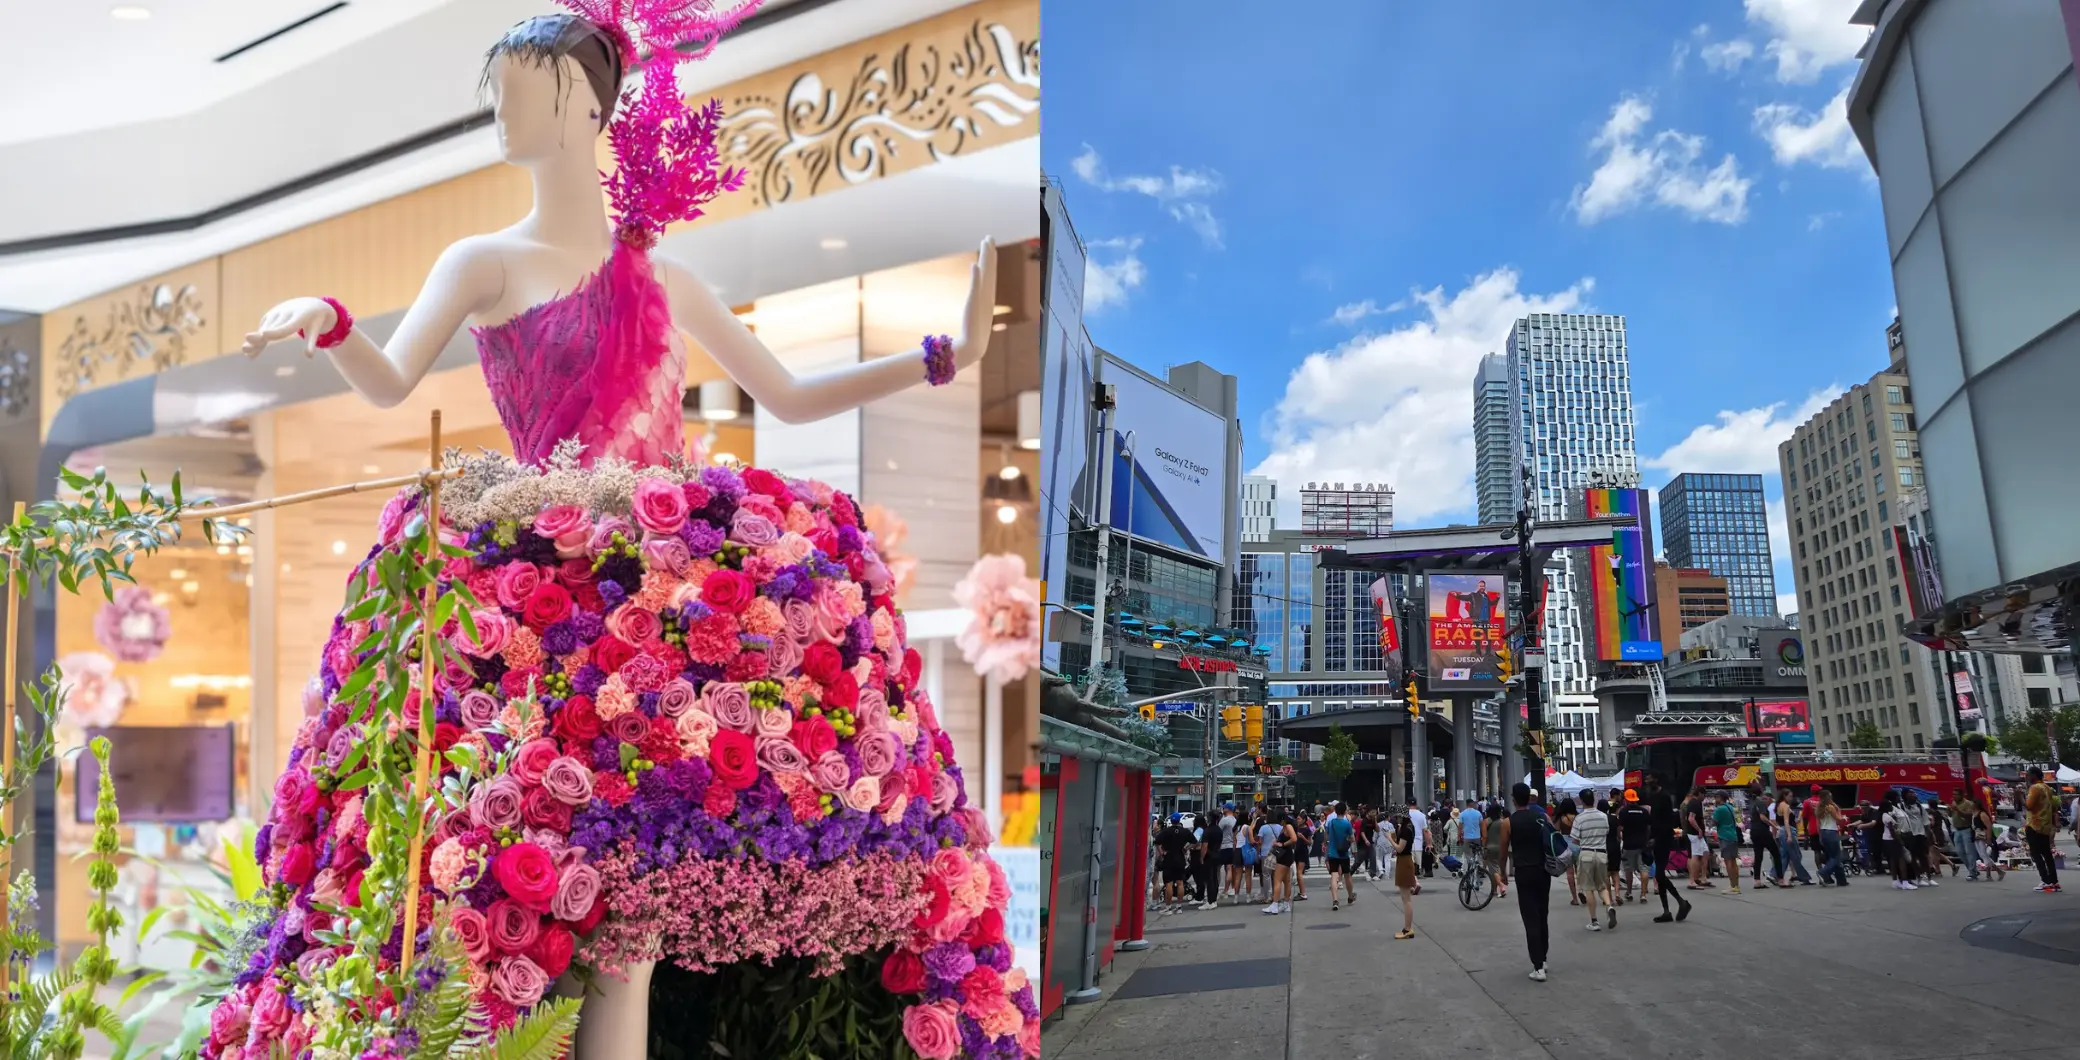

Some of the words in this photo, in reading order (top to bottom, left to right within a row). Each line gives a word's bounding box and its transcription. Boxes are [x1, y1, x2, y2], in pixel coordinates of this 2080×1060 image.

[1154, 447, 1183, 468] Galaxy
[1184, 459, 1189, 469] Z
[1190, 462, 1209, 476] Fold7
[1163, 464, 1186, 481] Galaxy
[1586, 467, 1643, 487] Citytv
[1307, 482, 1344, 490] SAM
[1353, 483, 1389, 492] SAM
[1434, 628, 1500, 640] RACE
[1843, 767, 1880, 780] Toronto
